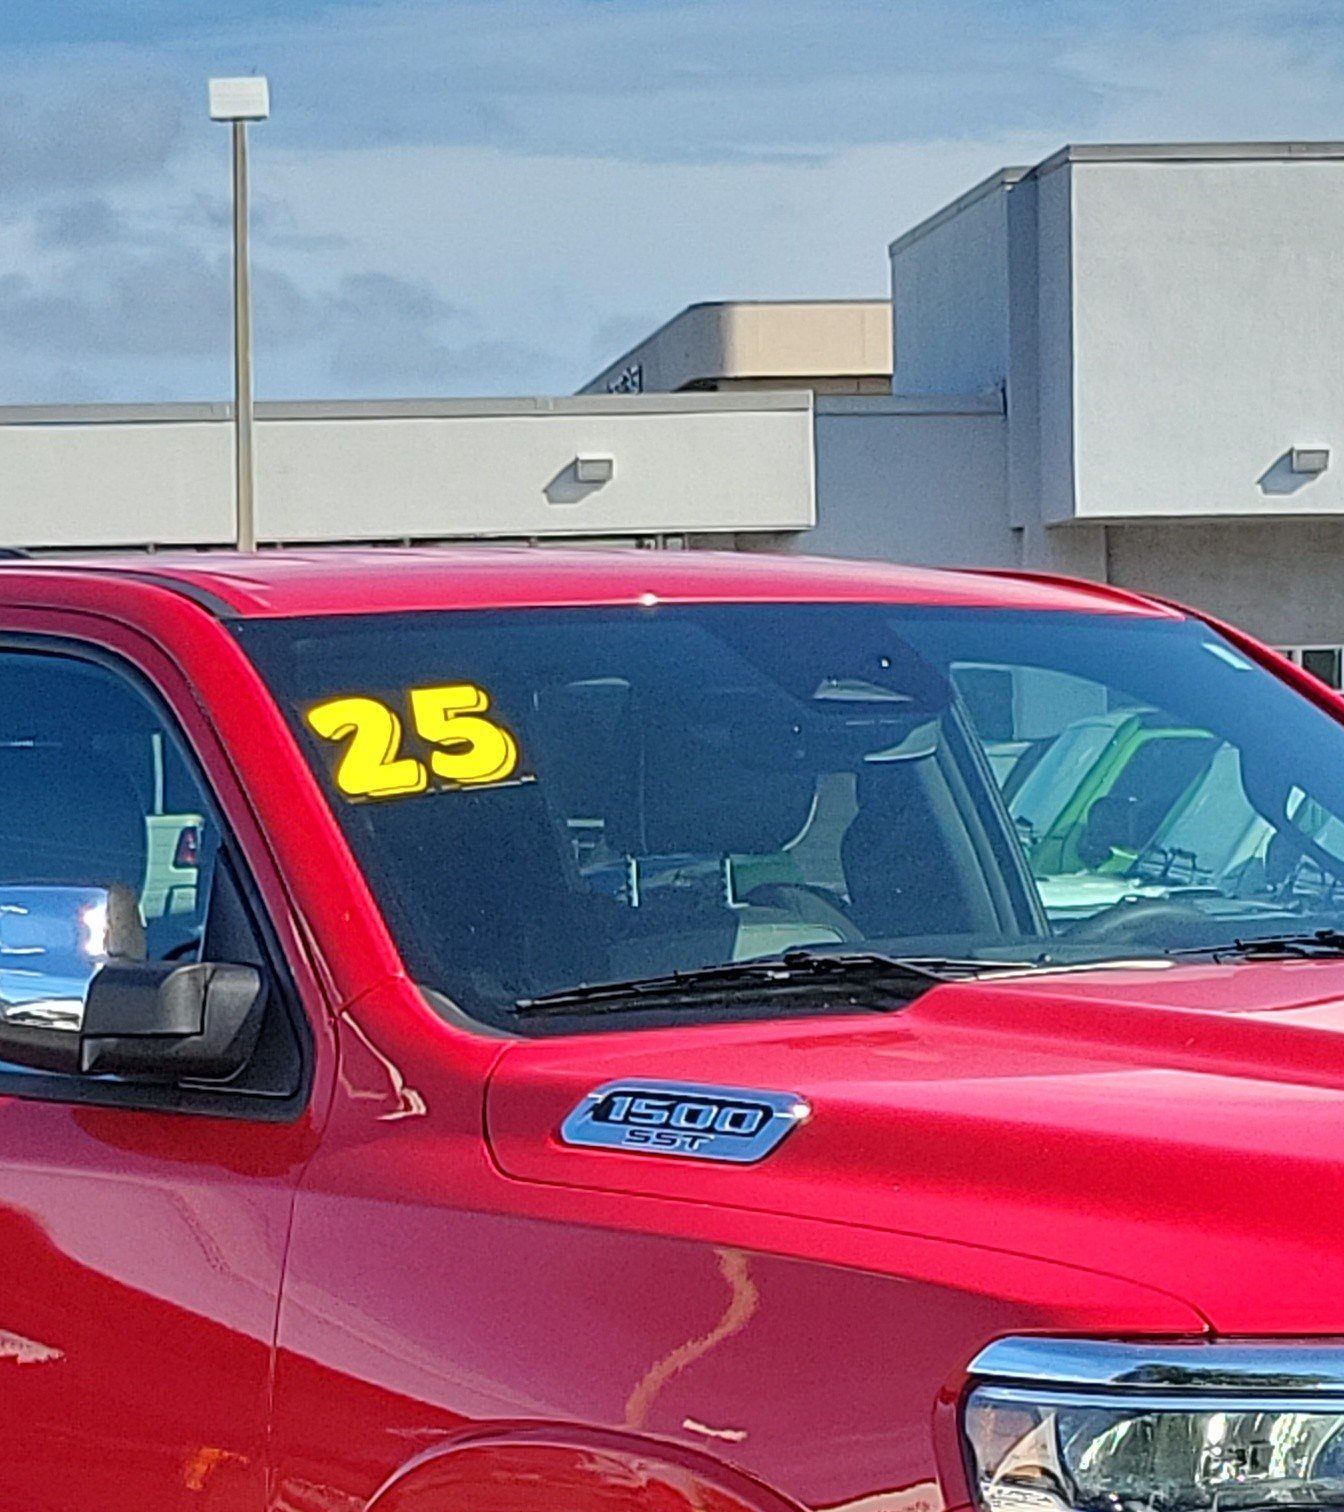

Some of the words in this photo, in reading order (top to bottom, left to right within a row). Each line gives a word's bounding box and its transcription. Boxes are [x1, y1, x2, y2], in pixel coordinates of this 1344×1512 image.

[306, 684, 517, 797] 25
[608, 1096, 764, 1134] 1500
[623, 1129, 716, 1151] SST
